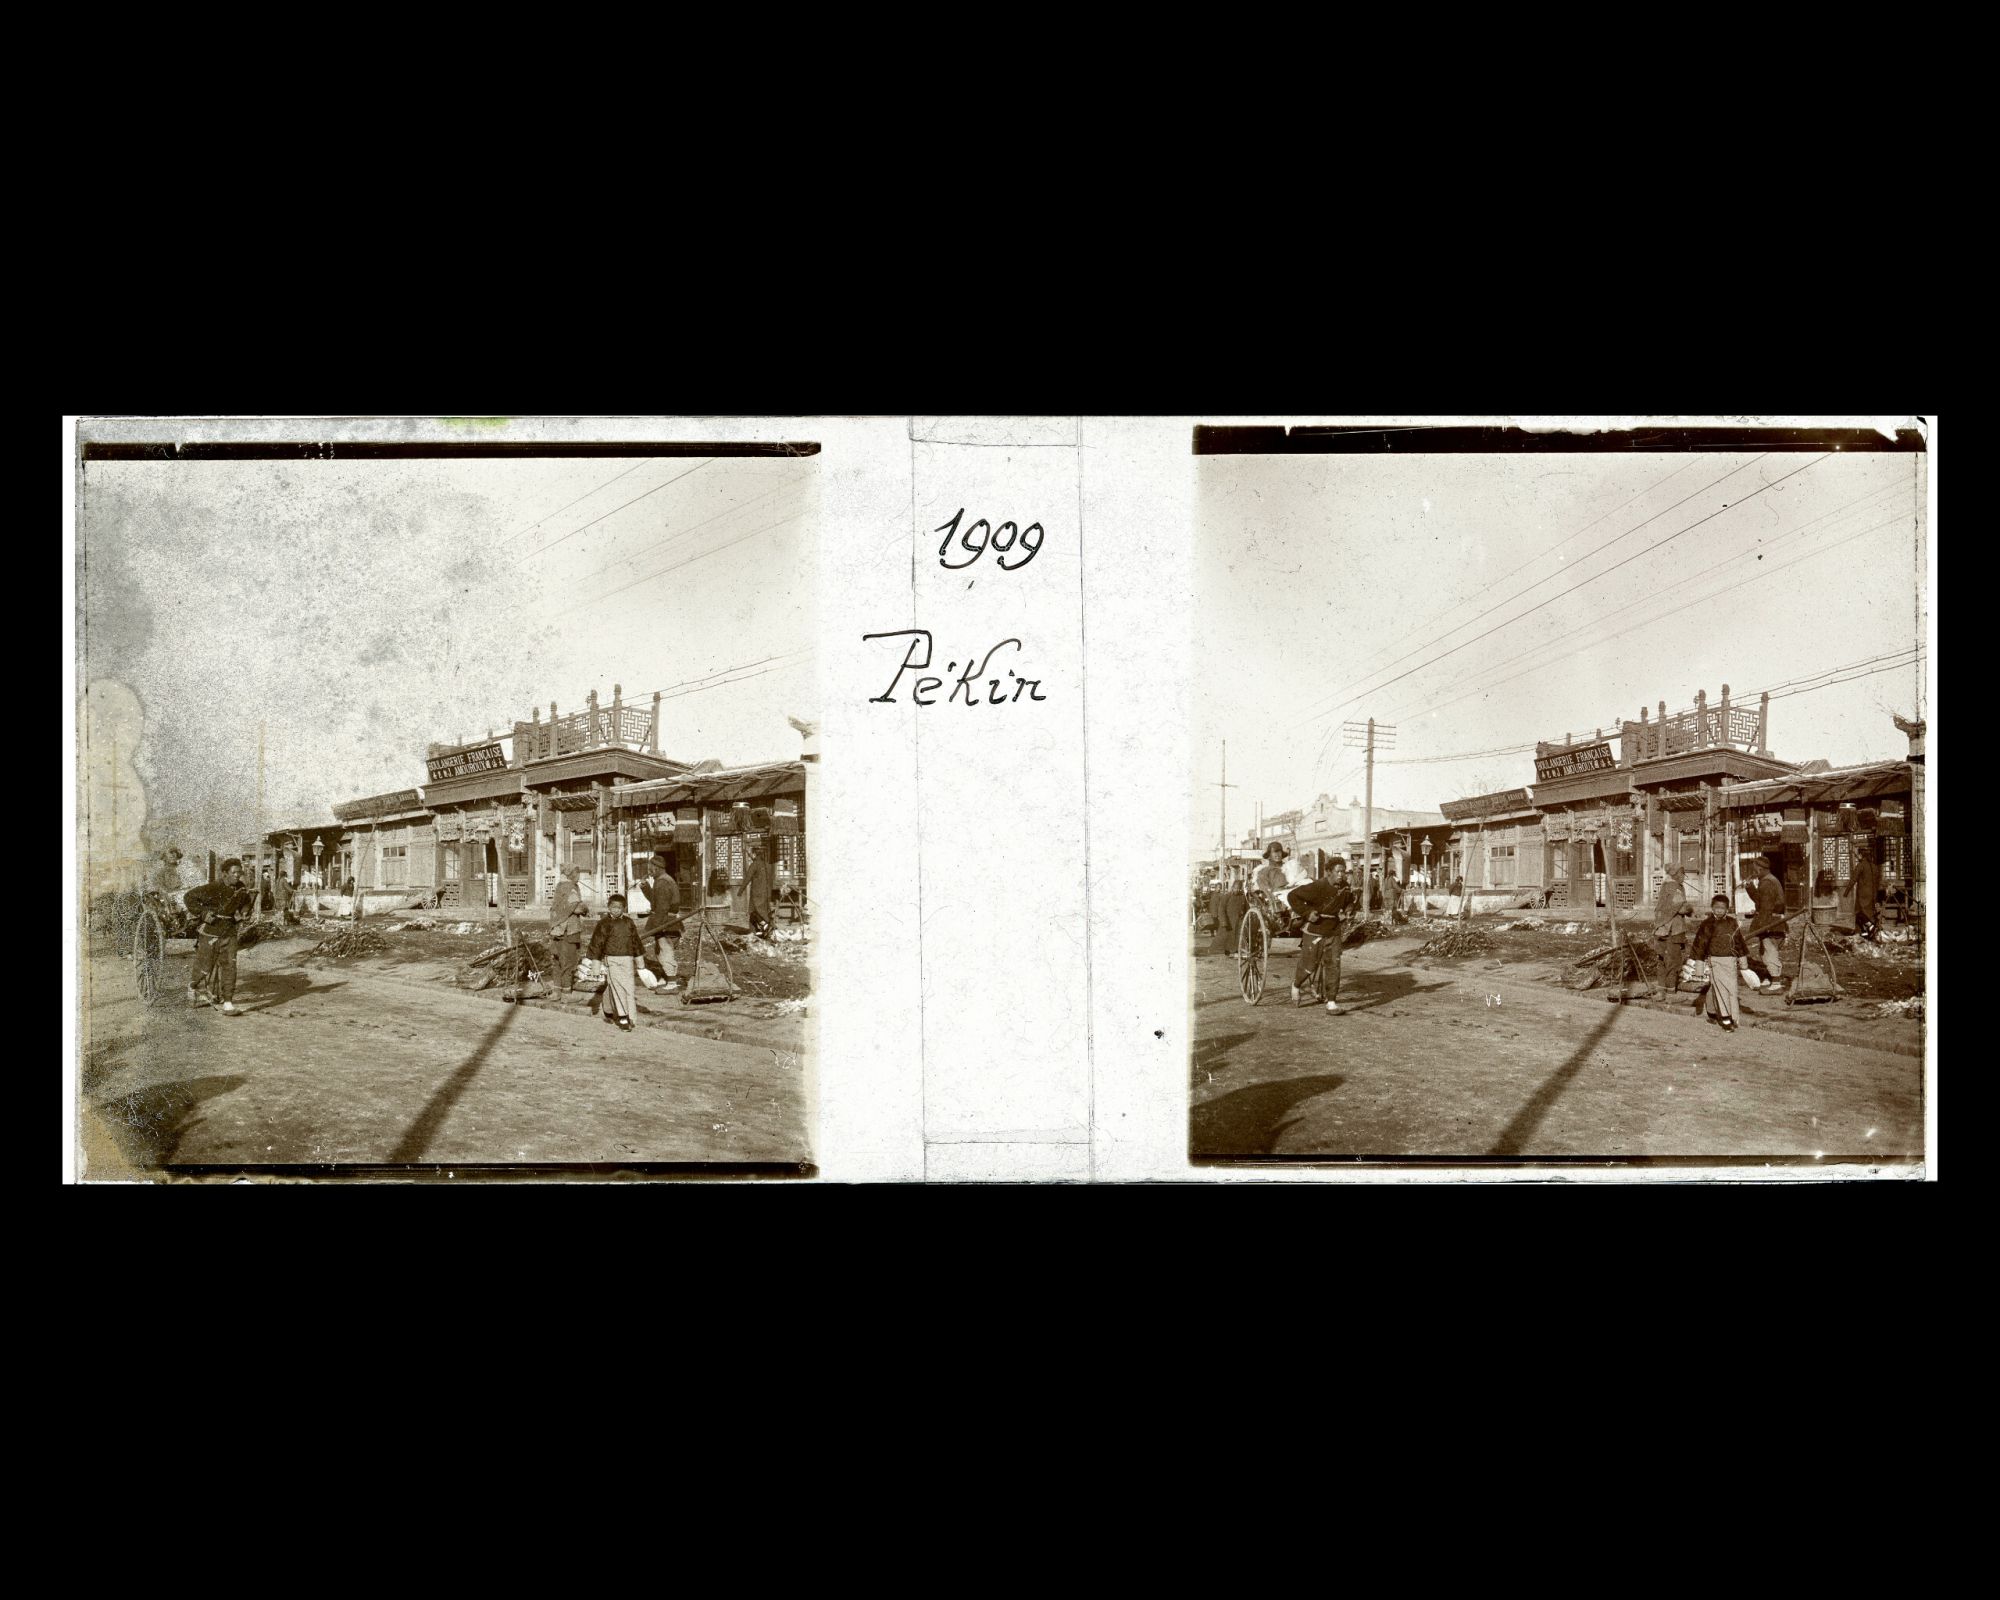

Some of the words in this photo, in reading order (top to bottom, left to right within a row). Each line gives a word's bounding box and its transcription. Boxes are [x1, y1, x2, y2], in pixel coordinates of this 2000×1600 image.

[934, 508, 1044, 570] 1909
[427, 754, 466, 771] BOULANGERIE
[466, 746, 502, 762] FRANÇAISE
[454, 760, 487, 776] AMOUROUX
[1536, 754, 1574, 771] BOULANGERIE
[1575, 746, 1611, 762] FRANÇAISE
[1563, 760, 1596, 776] AMOUROUX
